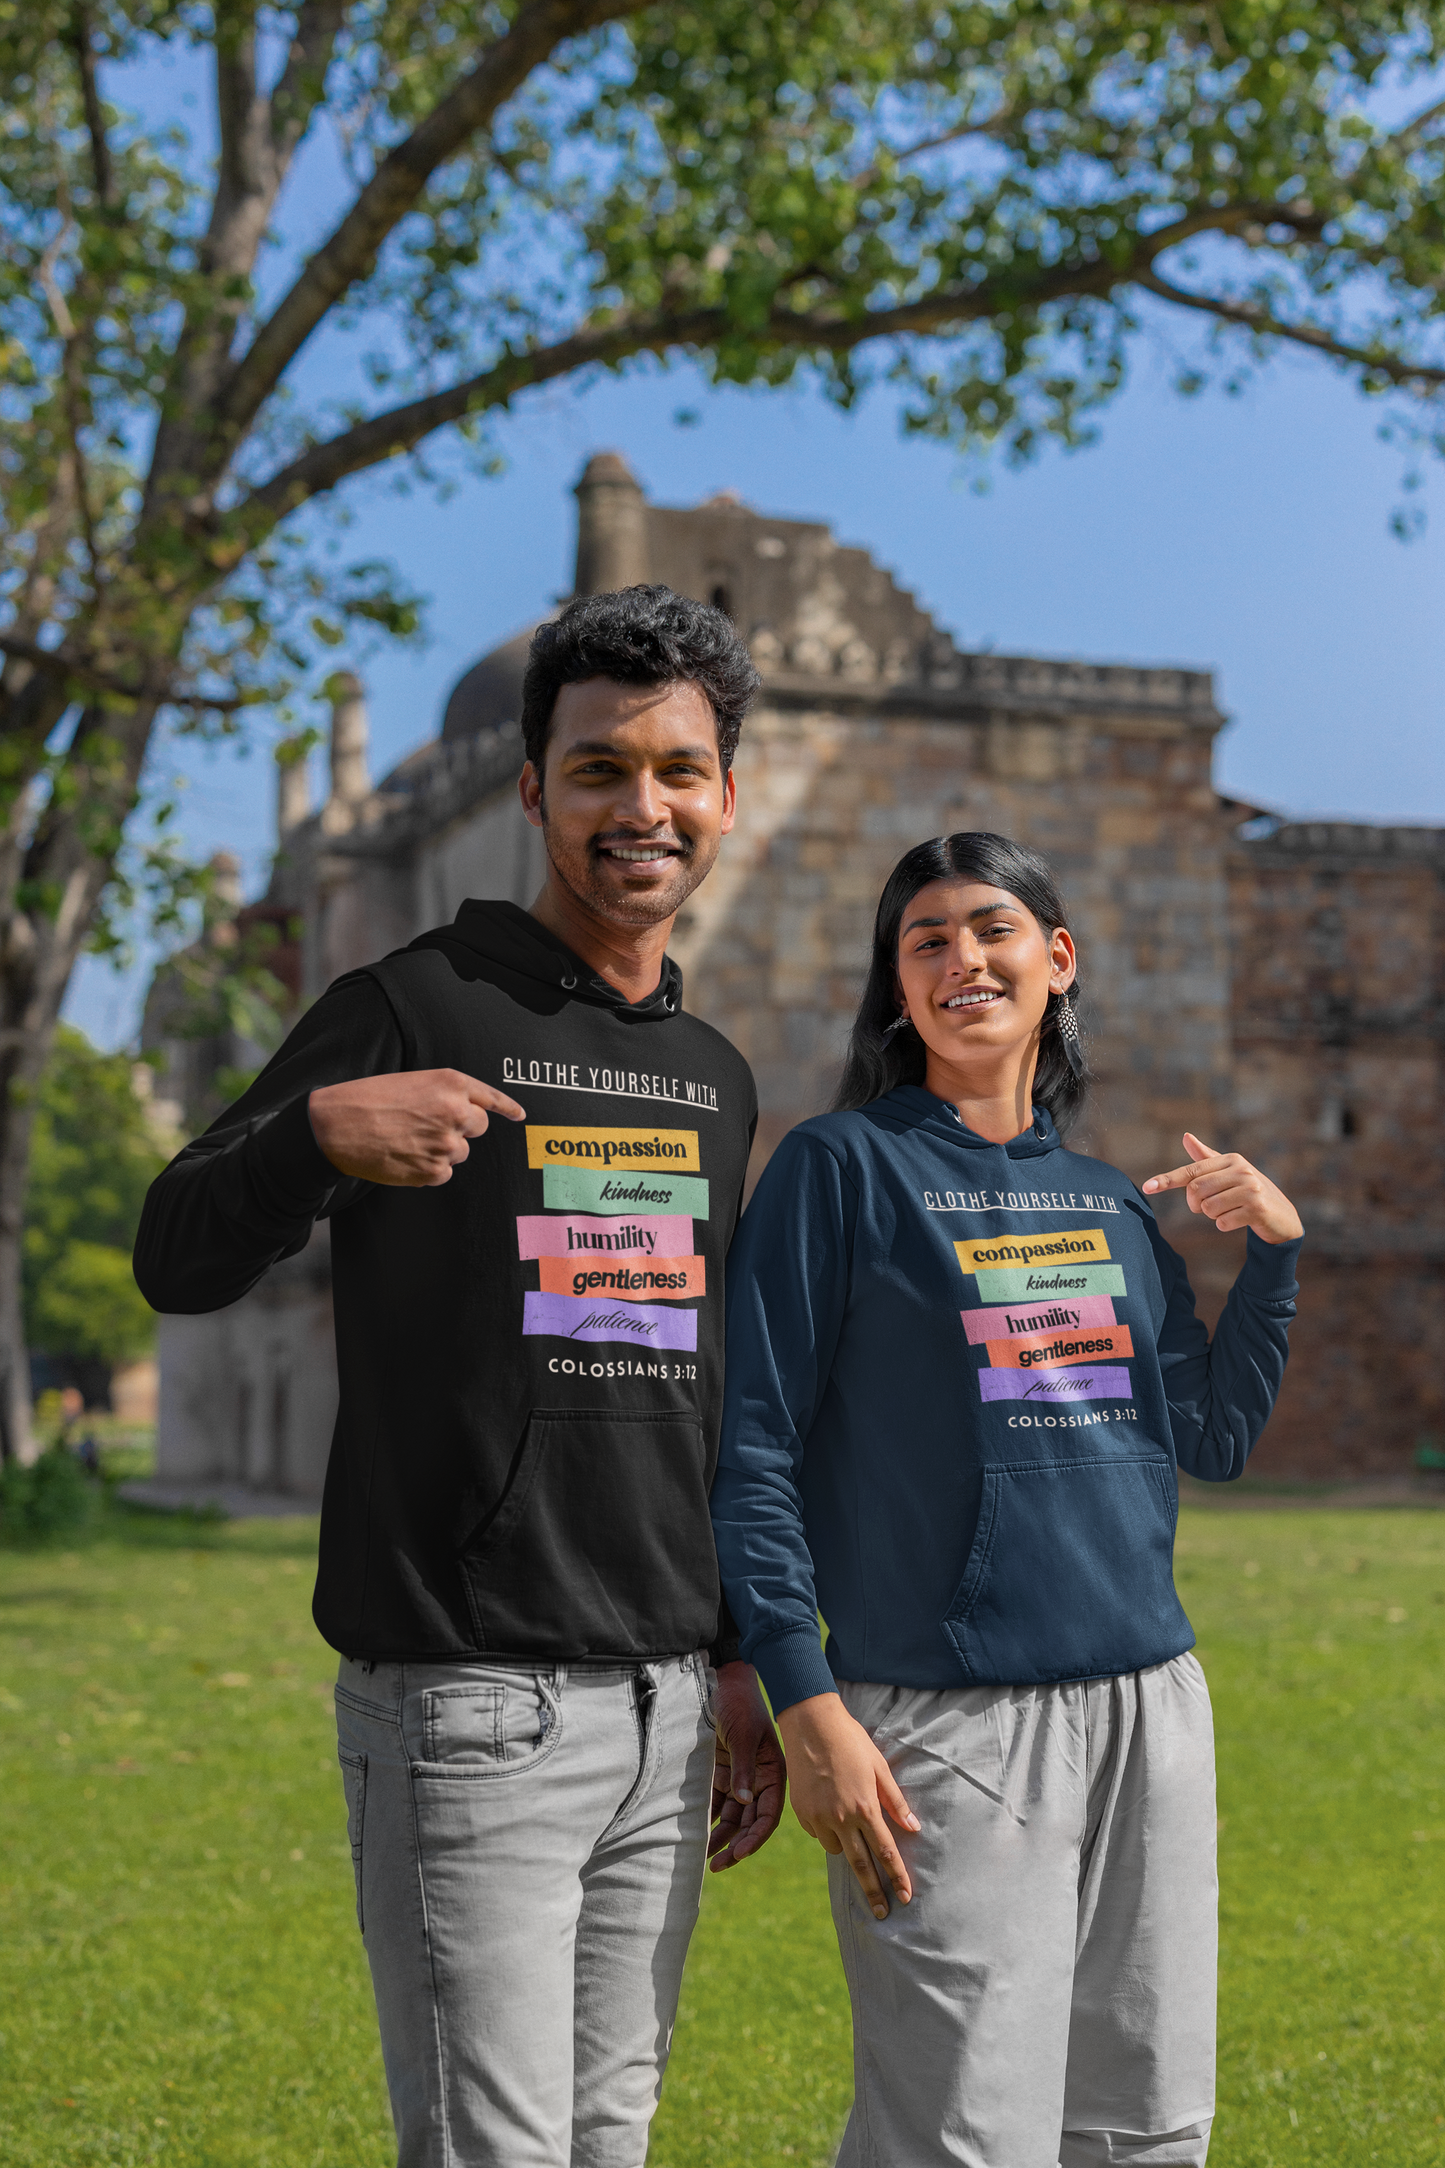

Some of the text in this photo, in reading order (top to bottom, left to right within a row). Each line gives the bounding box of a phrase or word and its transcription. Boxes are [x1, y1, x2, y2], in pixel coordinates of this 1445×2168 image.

[503, 1057, 718, 1107] CLOTHE YOURSELF WITH
[545, 1136, 687, 1165] compassion
[599, 1180, 673, 1204] kindness
[924, 1190, 1117, 1211] CLOTHE YOURSELF WITH
[567, 1225, 658, 1255] humility
[973, 1238, 1096, 1263] compassion
[573, 1269, 687, 1295] gentleness
[1026, 1274, 1087, 1291] kindness
[570, 1310, 659, 1337] patience
[1005, 1307, 1081, 1333] humility
[1018, 1338, 1114, 1367] gentleness
[548, 1358, 697, 1380] COLOSSIANS 3:12
[1022, 1375, 1094, 1398] patience
[1008, 1408, 1137, 1428] COLOSSIANS 3:12
